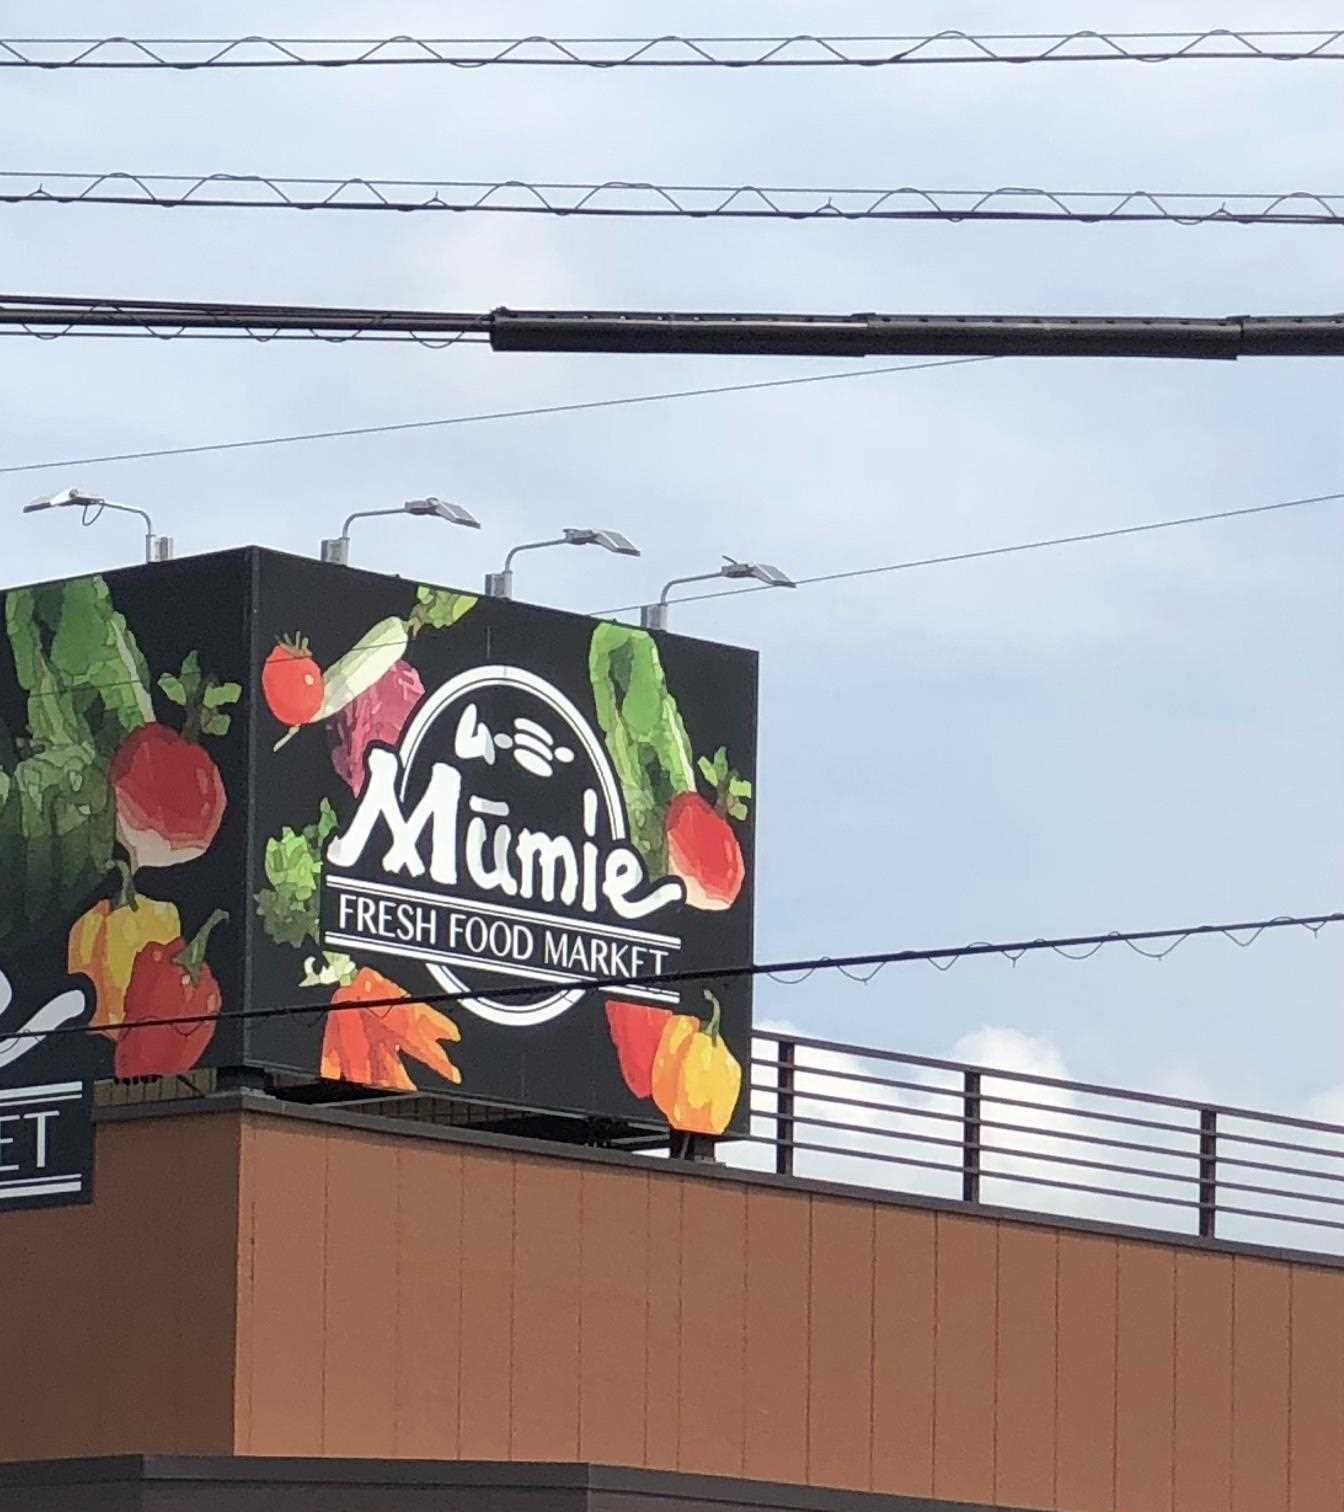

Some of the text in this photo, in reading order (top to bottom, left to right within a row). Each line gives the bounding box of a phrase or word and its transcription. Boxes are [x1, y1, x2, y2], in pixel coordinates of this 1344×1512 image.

[338, 894, 670, 978] FRESH FOOD MARKET
